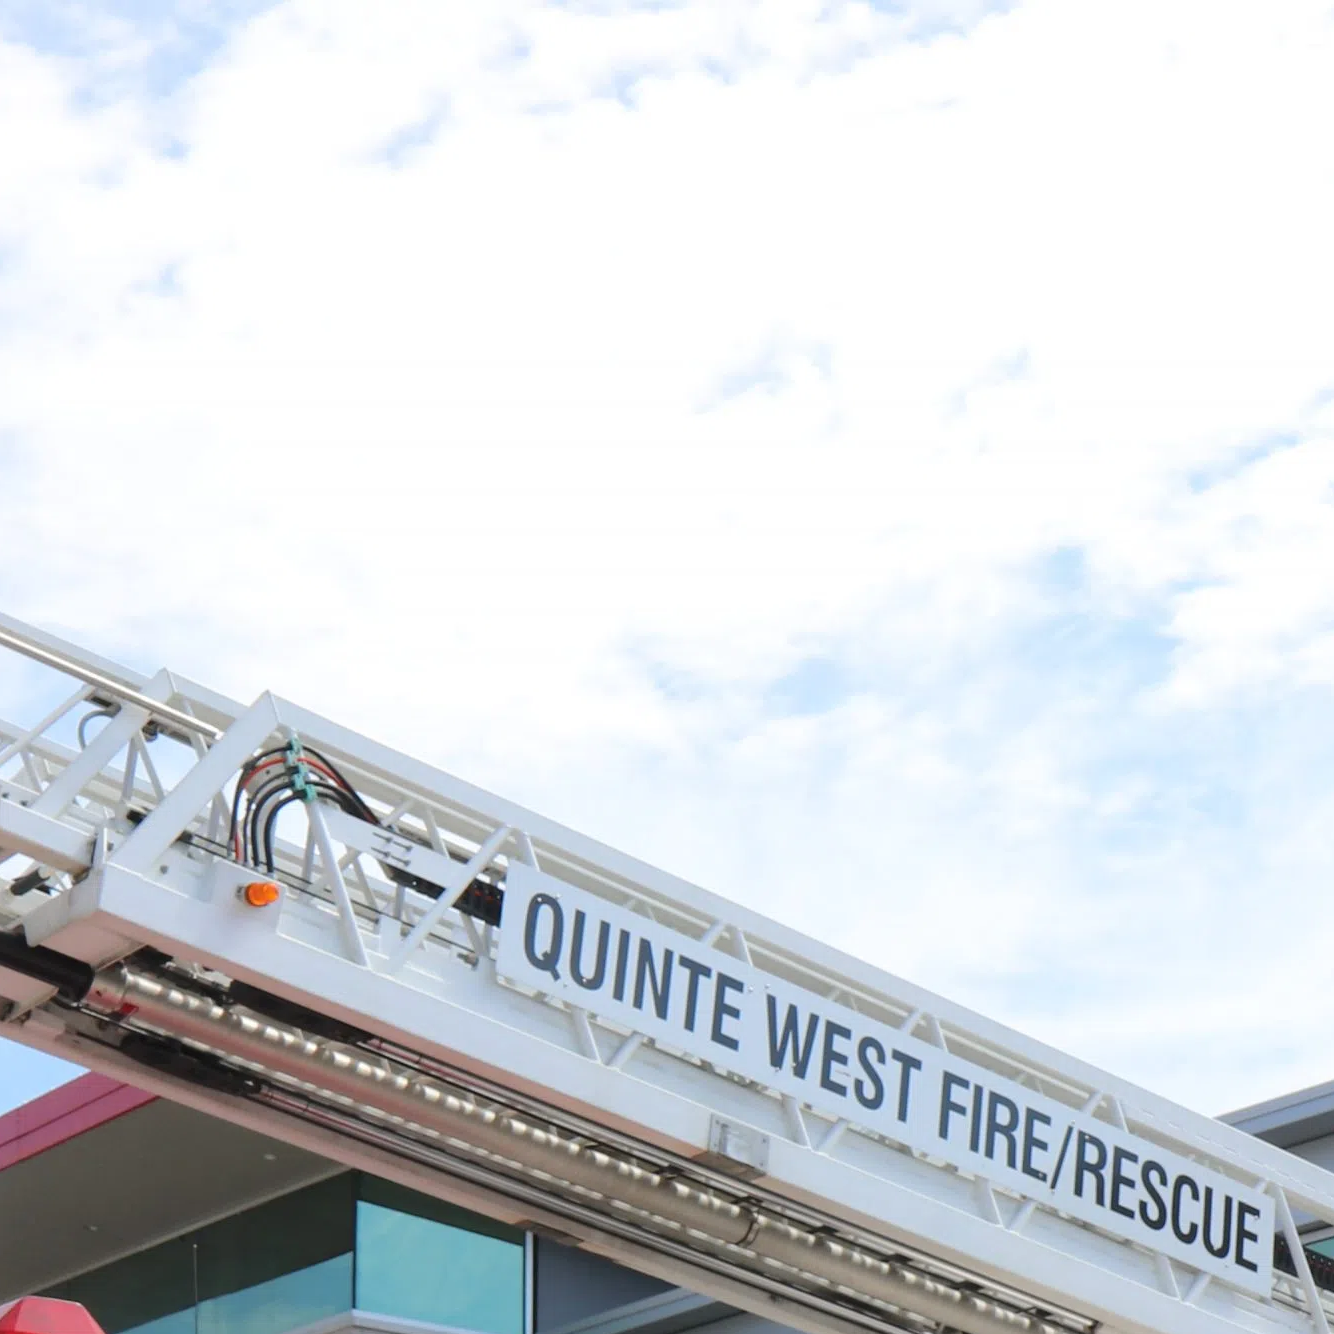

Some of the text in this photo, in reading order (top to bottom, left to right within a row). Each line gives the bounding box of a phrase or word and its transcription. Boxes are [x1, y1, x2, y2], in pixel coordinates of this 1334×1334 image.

[523, 892, 1261, 1273] QUINTE WEST FIRE/RESCUE
